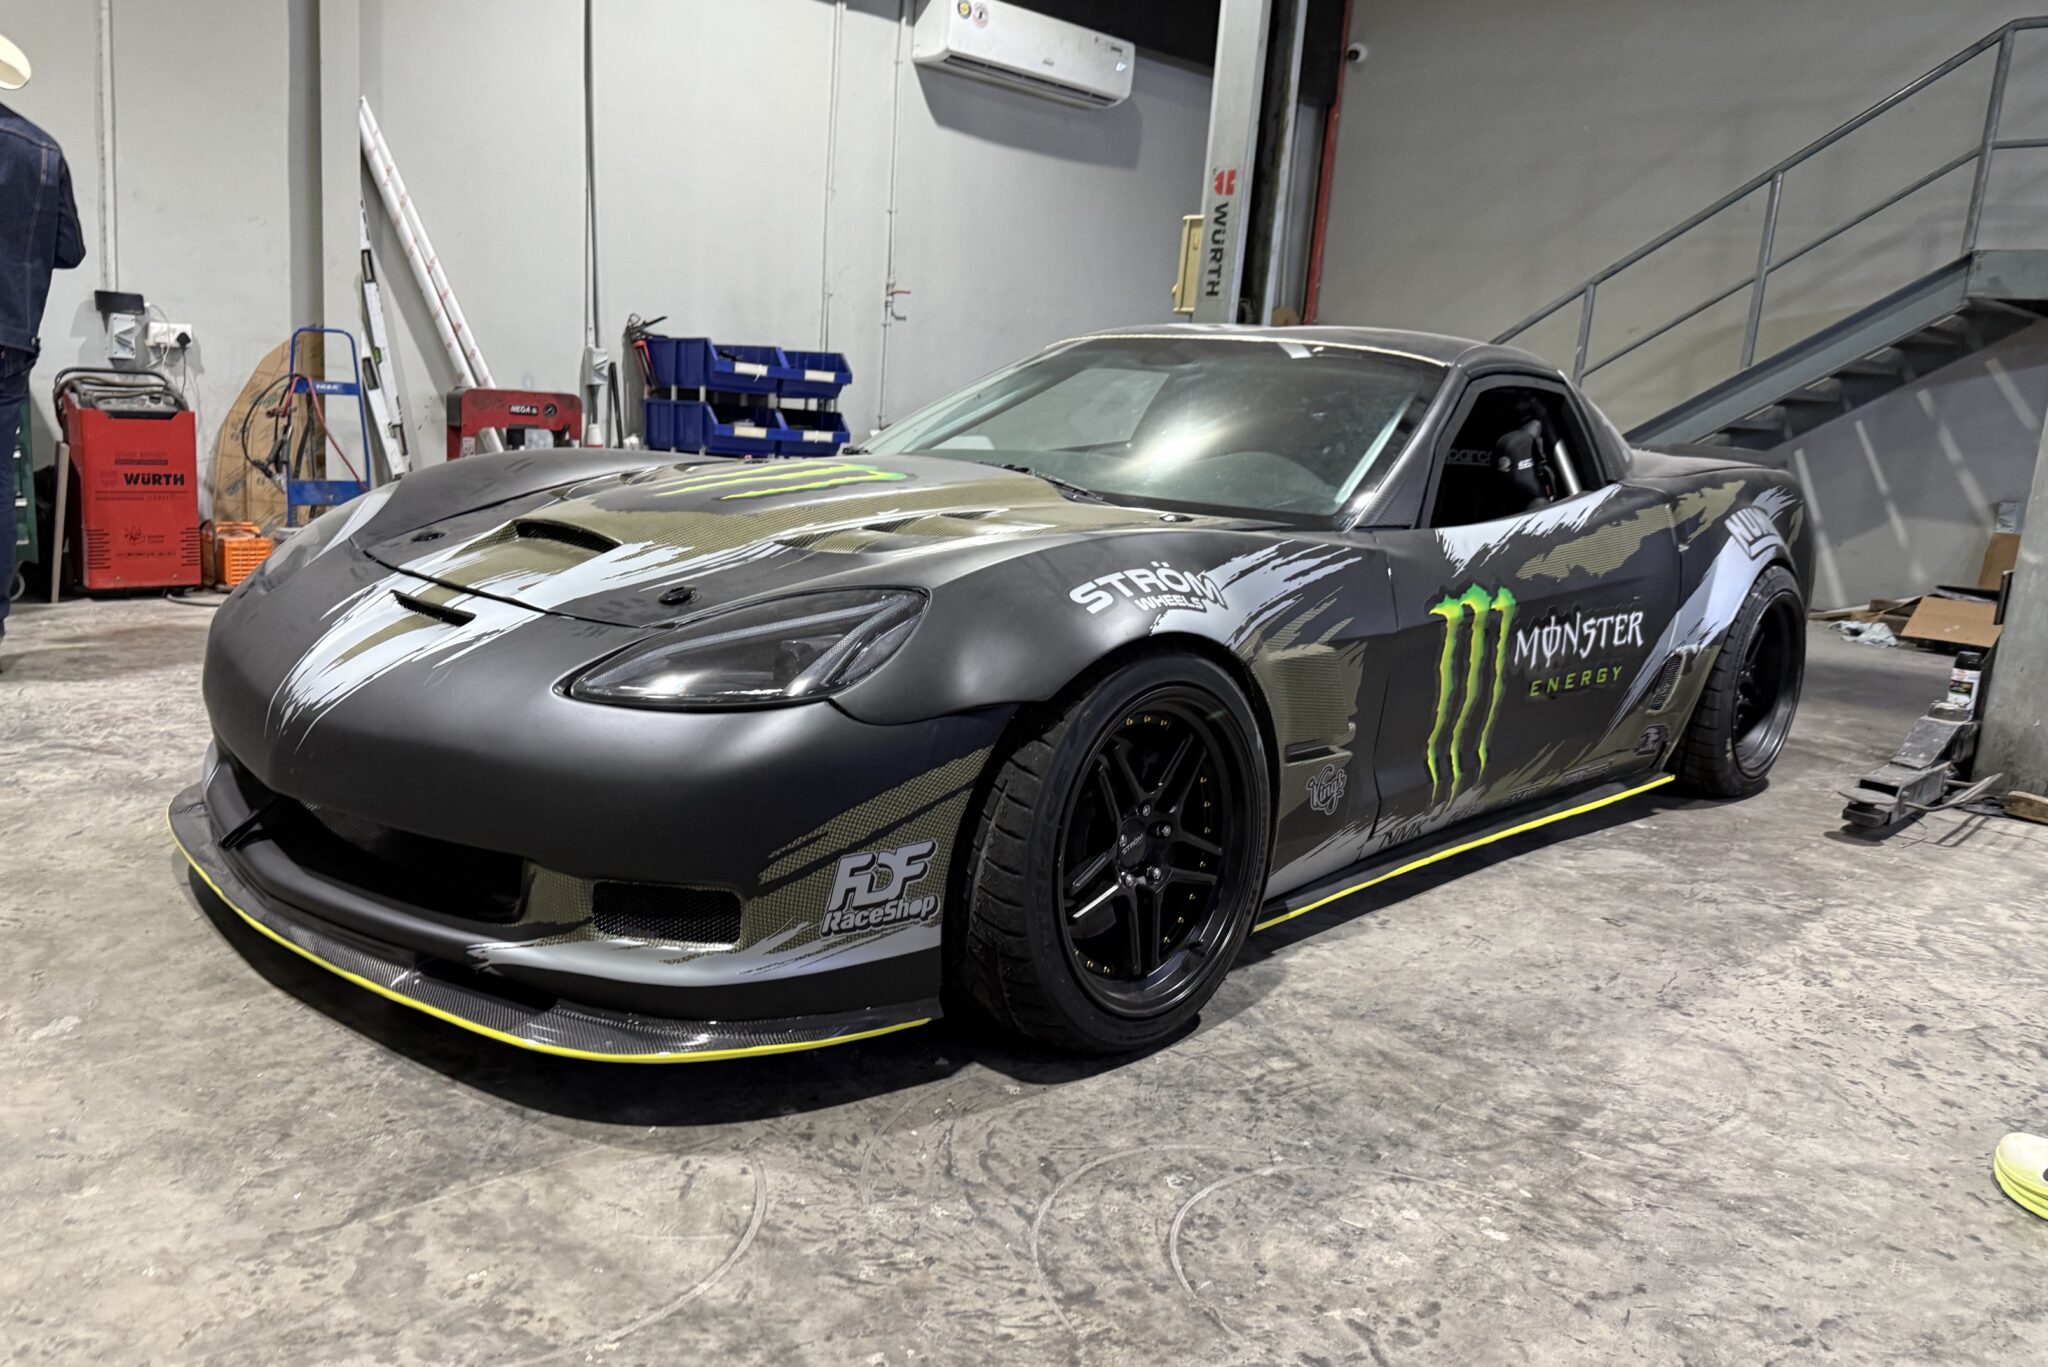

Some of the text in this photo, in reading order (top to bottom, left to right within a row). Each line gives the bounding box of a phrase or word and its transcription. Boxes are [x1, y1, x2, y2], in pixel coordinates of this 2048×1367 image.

[123, 472, 185, 486] WÜRTH
[1069, 561, 1228, 615] STRÖM
[1134, 594, 1204, 612] WHEELS
[1529, 665, 1623, 697] ENERGY
